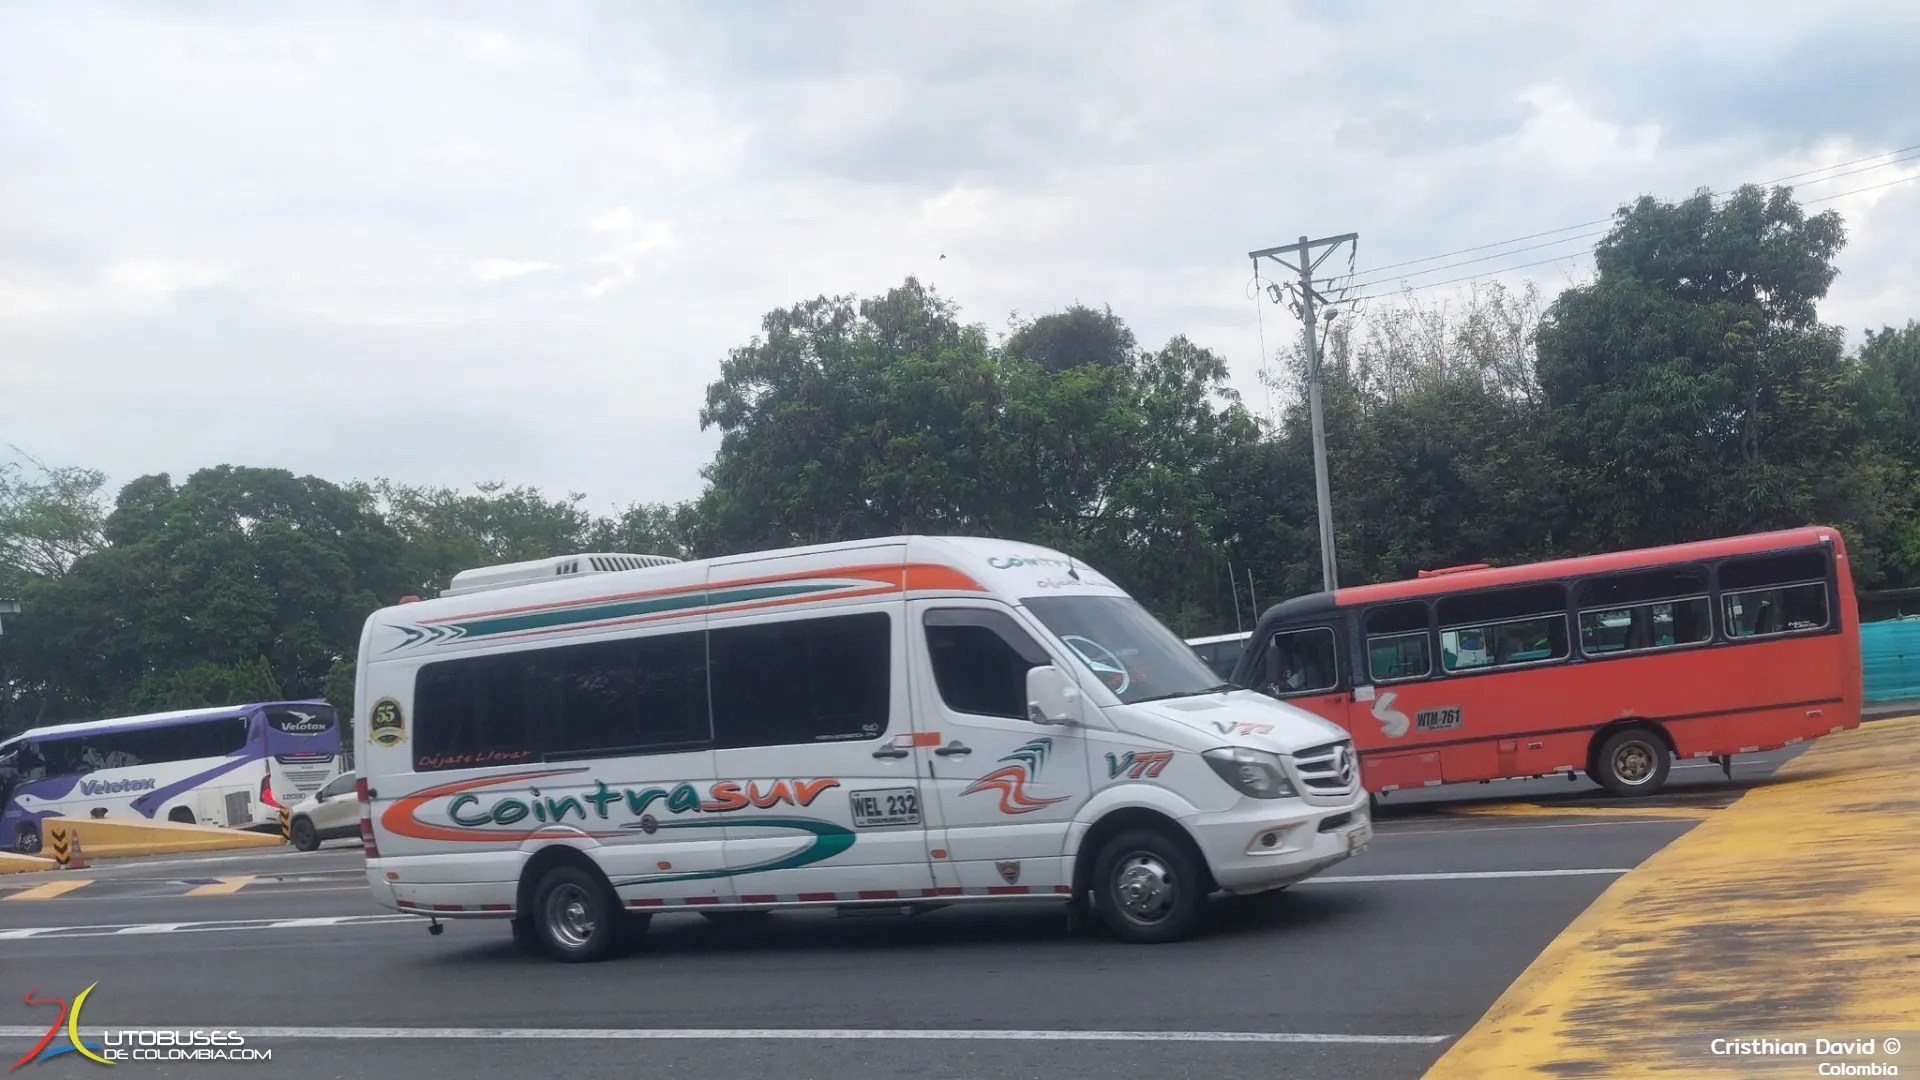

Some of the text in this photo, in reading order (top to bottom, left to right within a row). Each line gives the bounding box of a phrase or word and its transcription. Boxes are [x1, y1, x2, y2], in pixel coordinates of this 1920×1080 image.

[376, 705, 396, 723] 55
[281, 722, 326, 731] Velotax
[1212, 720, 1275, 736] V77
[1104, 750, 1174, 780] V77
[80, 778, 156, 796] Velotax
[447, 776, 840, 827] Cointrasur
[851, 794, 919, 817] WEL 232
